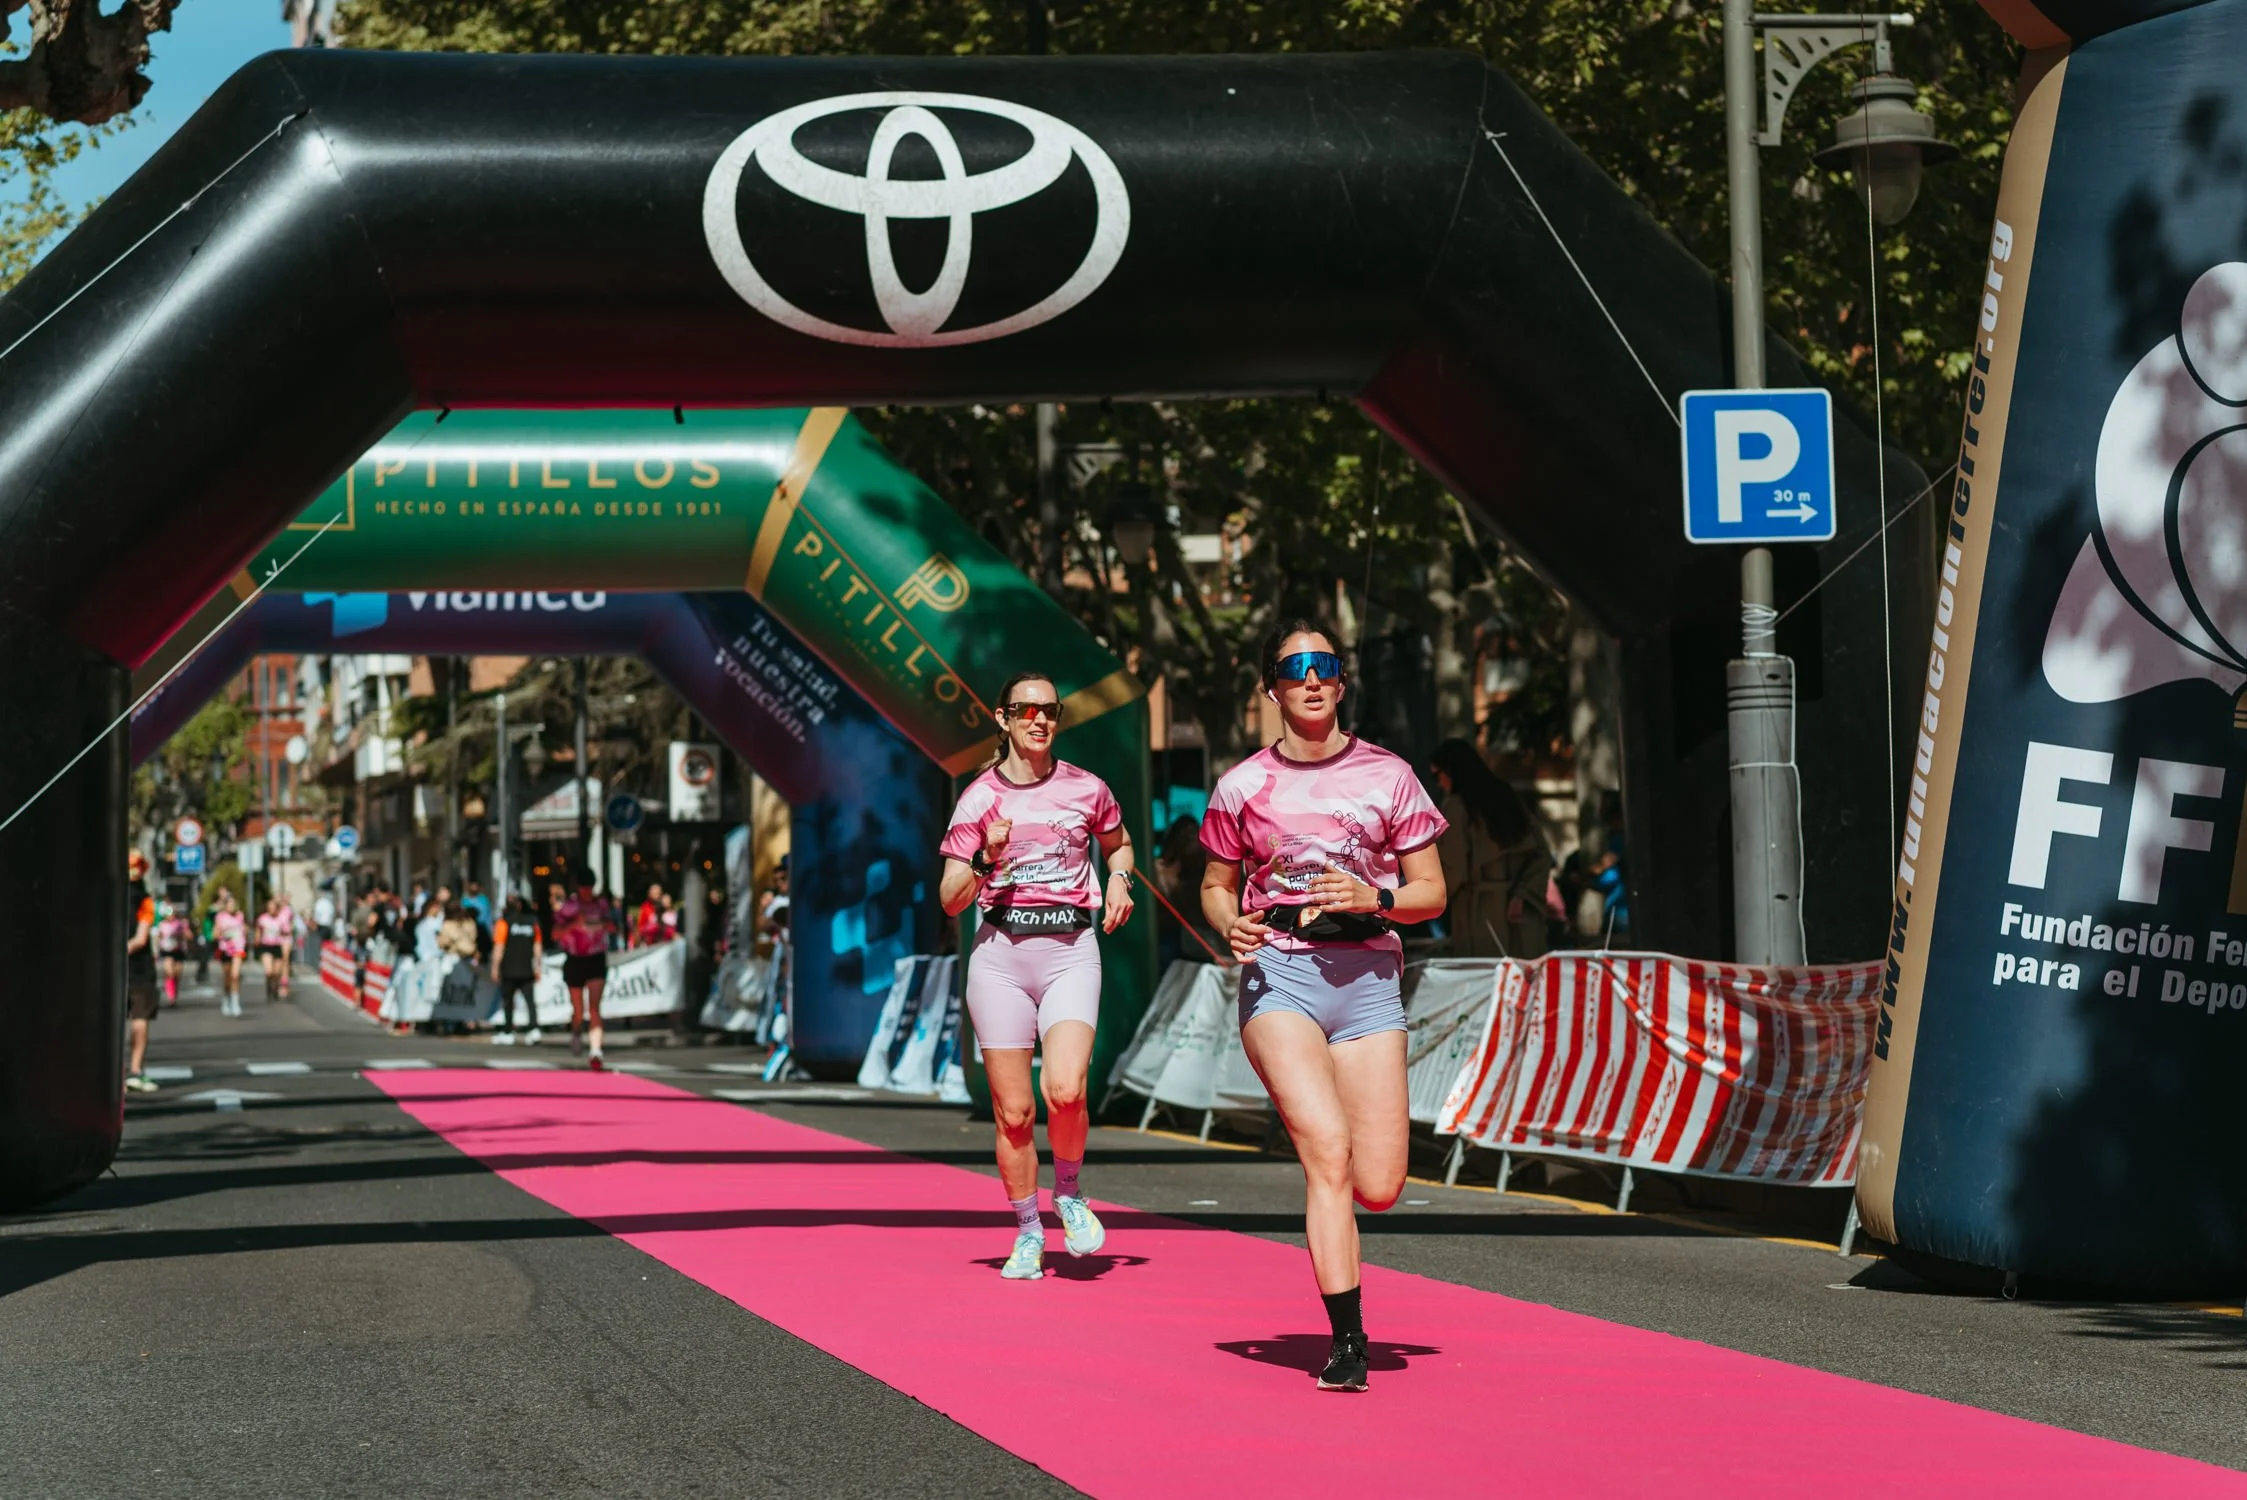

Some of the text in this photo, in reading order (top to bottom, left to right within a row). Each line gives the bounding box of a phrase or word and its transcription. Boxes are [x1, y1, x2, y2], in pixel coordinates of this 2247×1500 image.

[1714, 409, 1800, 523] P
[375, 499, 722, 516] HECHO EN ESPAÑA DESDE 1981
[1773, 489, 1811, 503] 30 m
[750, 612, 779, 648] Tu
[793, 530, 981, 729] PITILLOS
[715, 647, 806, 743] vocación.
[732, 635, 826, 726] nuestra
[1282, 855, 1293, 864] XI
[1288, 874, 1305, 884] por
[1042, 909, 1077, 925] MAX
[2000, 902, 2195, 962] Fundación
[1992, 952, 2247, 1015] para el Depo
